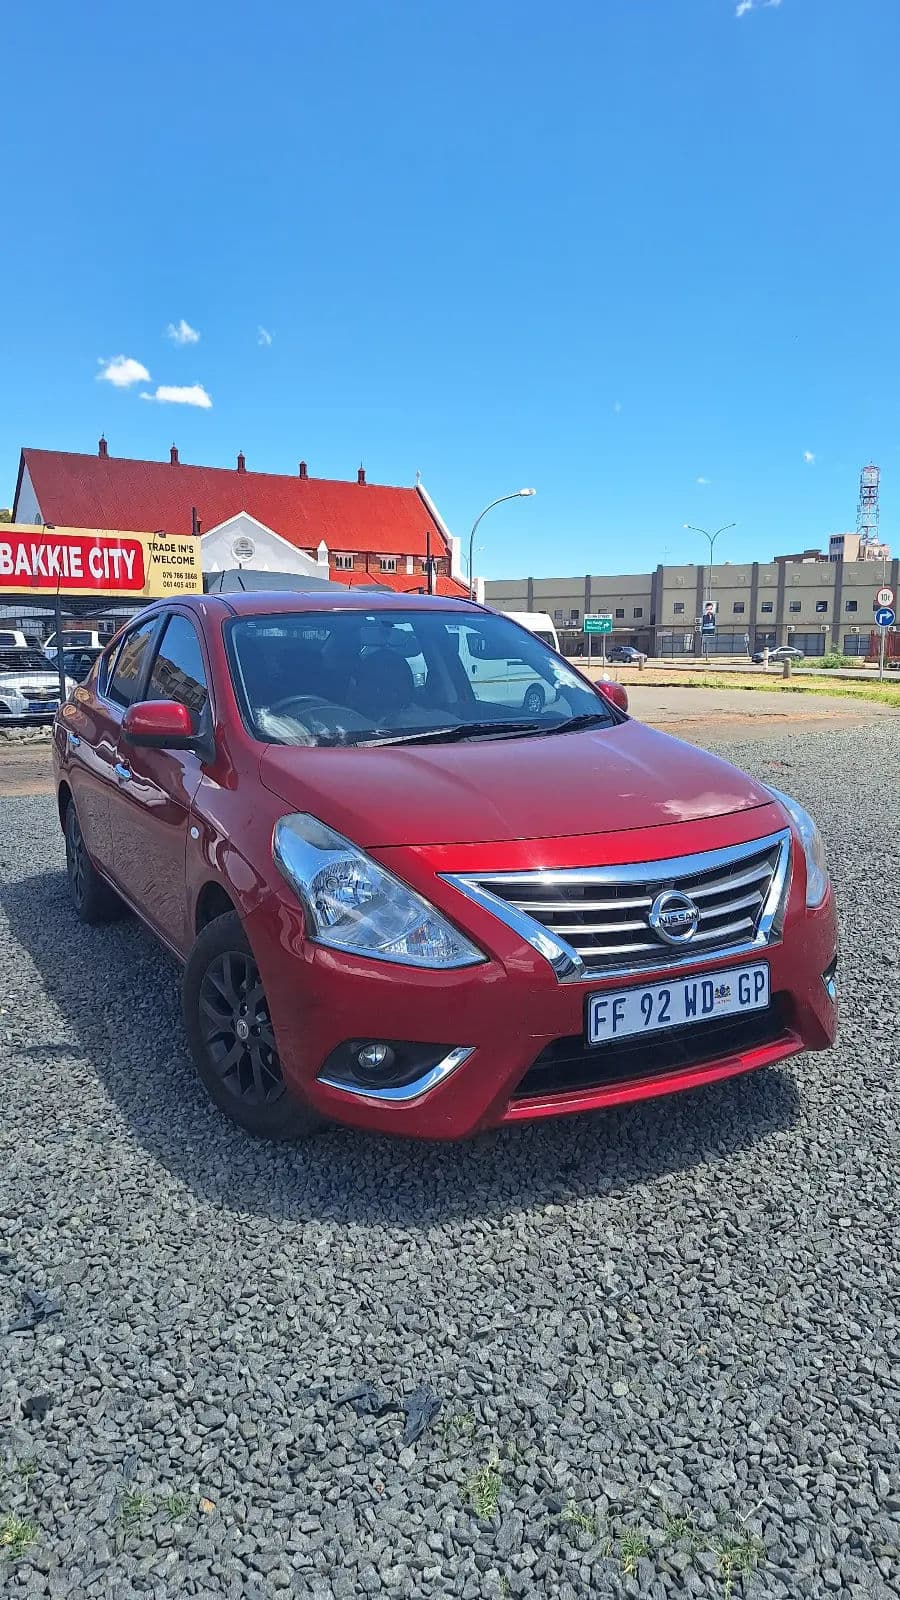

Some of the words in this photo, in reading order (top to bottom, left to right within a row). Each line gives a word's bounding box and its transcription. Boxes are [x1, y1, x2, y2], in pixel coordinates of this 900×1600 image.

[147, 542, 176, 553] TRADE
[178, 544, 194, 554] IN'S
[0, 542, 84, 578] BAKKIE
[88, 546, 136, 580] CITY
[152, 555, 195, 566] WELCOME
[659, 908, 700, 924] NISSAN
[594, 997, 627, 1036] FF
[640, 989, 671, 1026] 92
[684, 980, 714, 1017] WD
[738, 970, 765, 1005] GP
